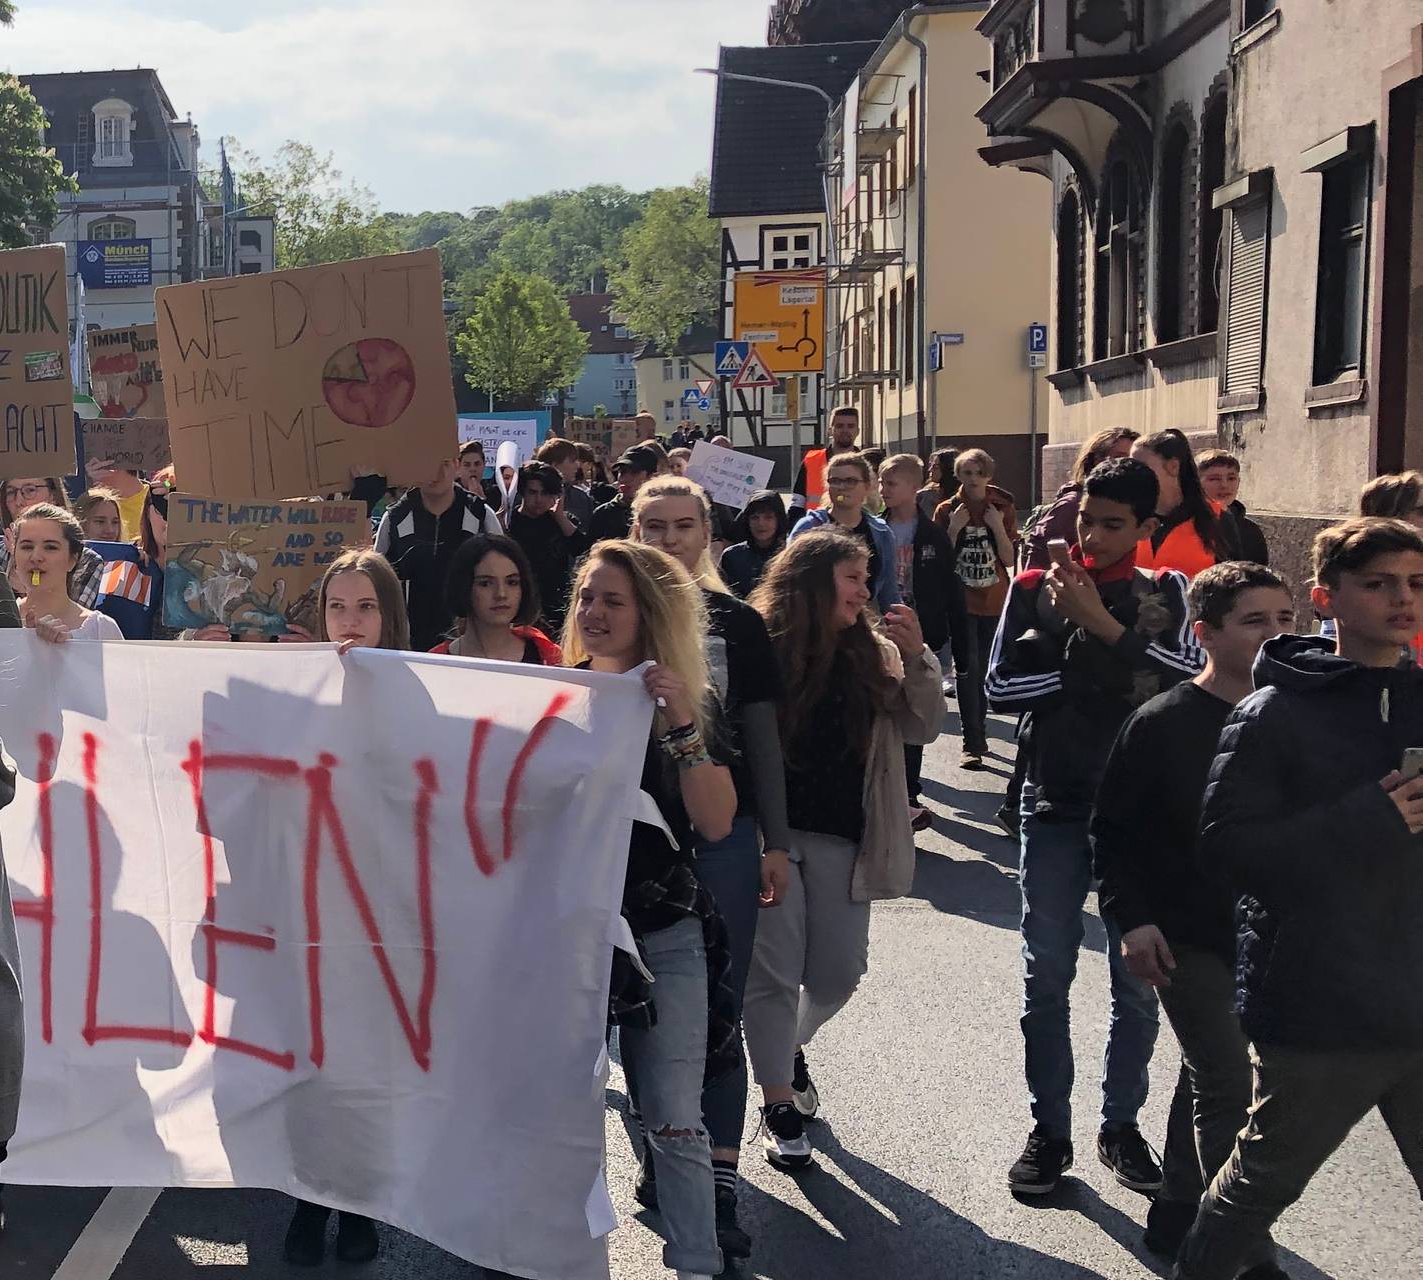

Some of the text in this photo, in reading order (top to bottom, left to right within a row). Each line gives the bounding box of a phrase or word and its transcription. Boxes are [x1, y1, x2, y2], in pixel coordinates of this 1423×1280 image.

[105, 244, 149, 256] Münch
[163, 285, 241, 362] WE
[93, 332, 137, 348] IMMER
[1033, 328, 1043, 348] P
[173, 366, 248, 407] HAVE
[81, 422, 126, 434] CHANGE
[179, 405, 347, 498] TIME
[178, 498, 357, 524] THE WATER WILL RISE
[285, 530, 344, 548] AND SO
[272, 552, 305, 567] ARE
